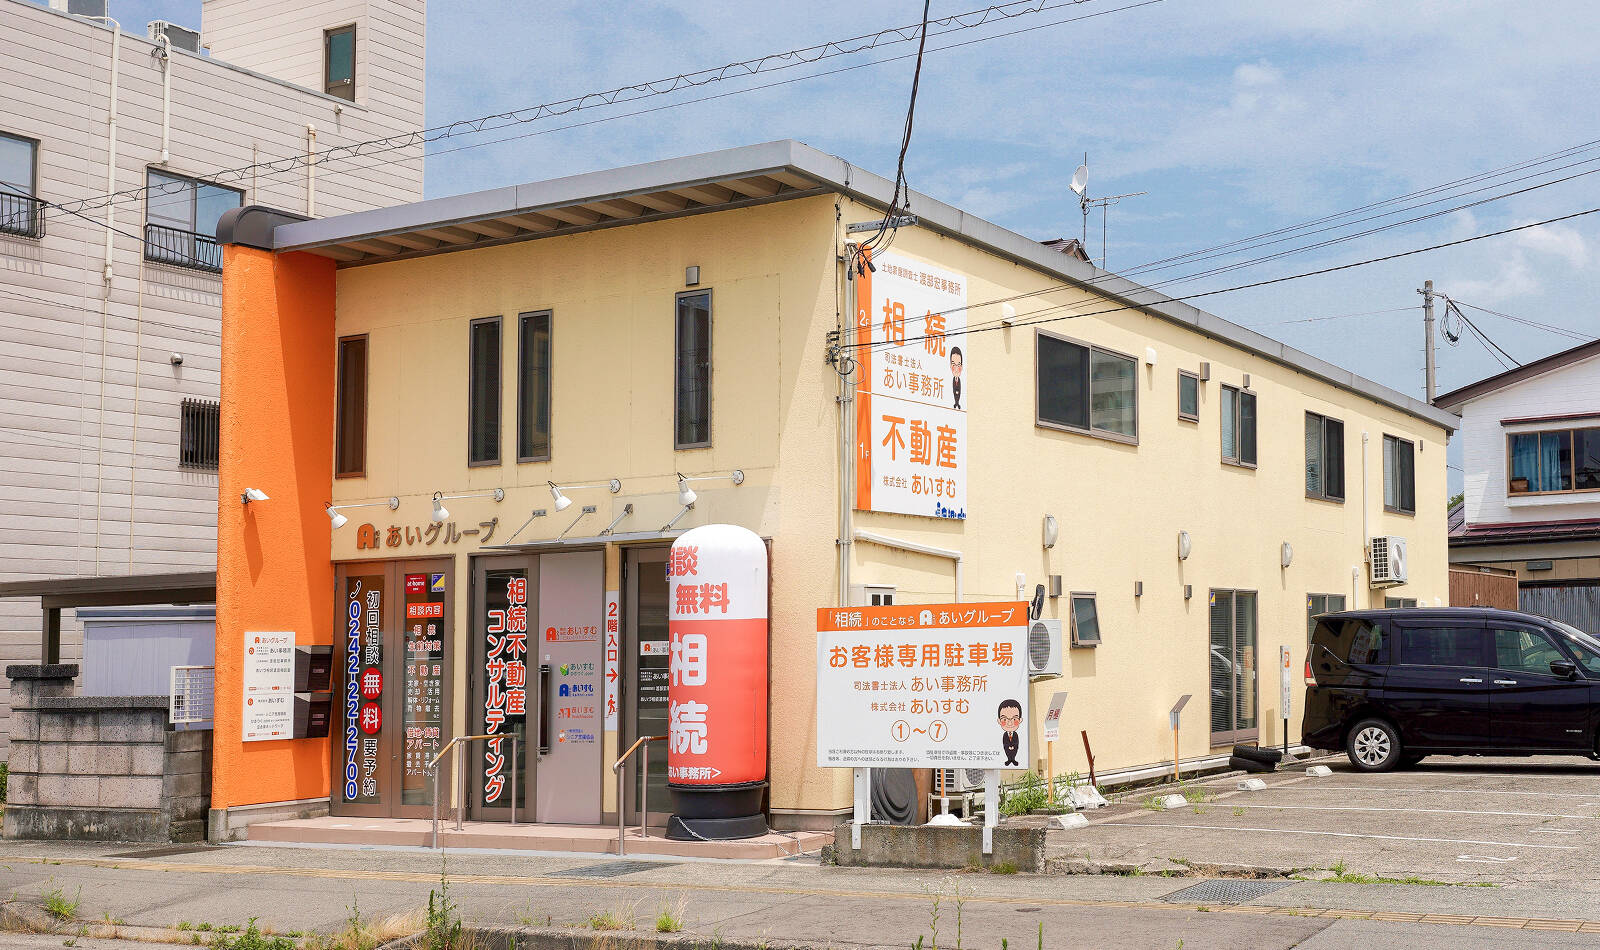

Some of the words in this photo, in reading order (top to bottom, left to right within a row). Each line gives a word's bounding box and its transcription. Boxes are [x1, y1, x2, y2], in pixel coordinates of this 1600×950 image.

[883, 366, 944, 400] あい事務所
[882, 414, 957, 469] 不動産
[910, 472, 957, 499] あいすむ
[386, 517, 498, 548] あいグループ
[675, 581, 731, 614] 無料
[365, 590, 380, 665] 初回相談
[566, 626, 598, 636] あいすむ
[607, 601, 618, 662] 2階入口
[939, 607, 1015, 626] あいグループ
[505, 577, 528, 716] 相続不動産
[829, 642, 1014, 668] お客様専用駐車場
[345, 600, 361, 800] 0242-22-2700
[853, 680, 907, 691] 司法書士法人
[910, 674, 988, 693] あい事務所
[362, 673, 380, 730] 無料
[485, 608, 506, 803] コンサルティング
[870, 701, 907, 712] 株式会社
[910, 697, 970, 715] あいすむ
[362, 738, 378, 797] 要予約
